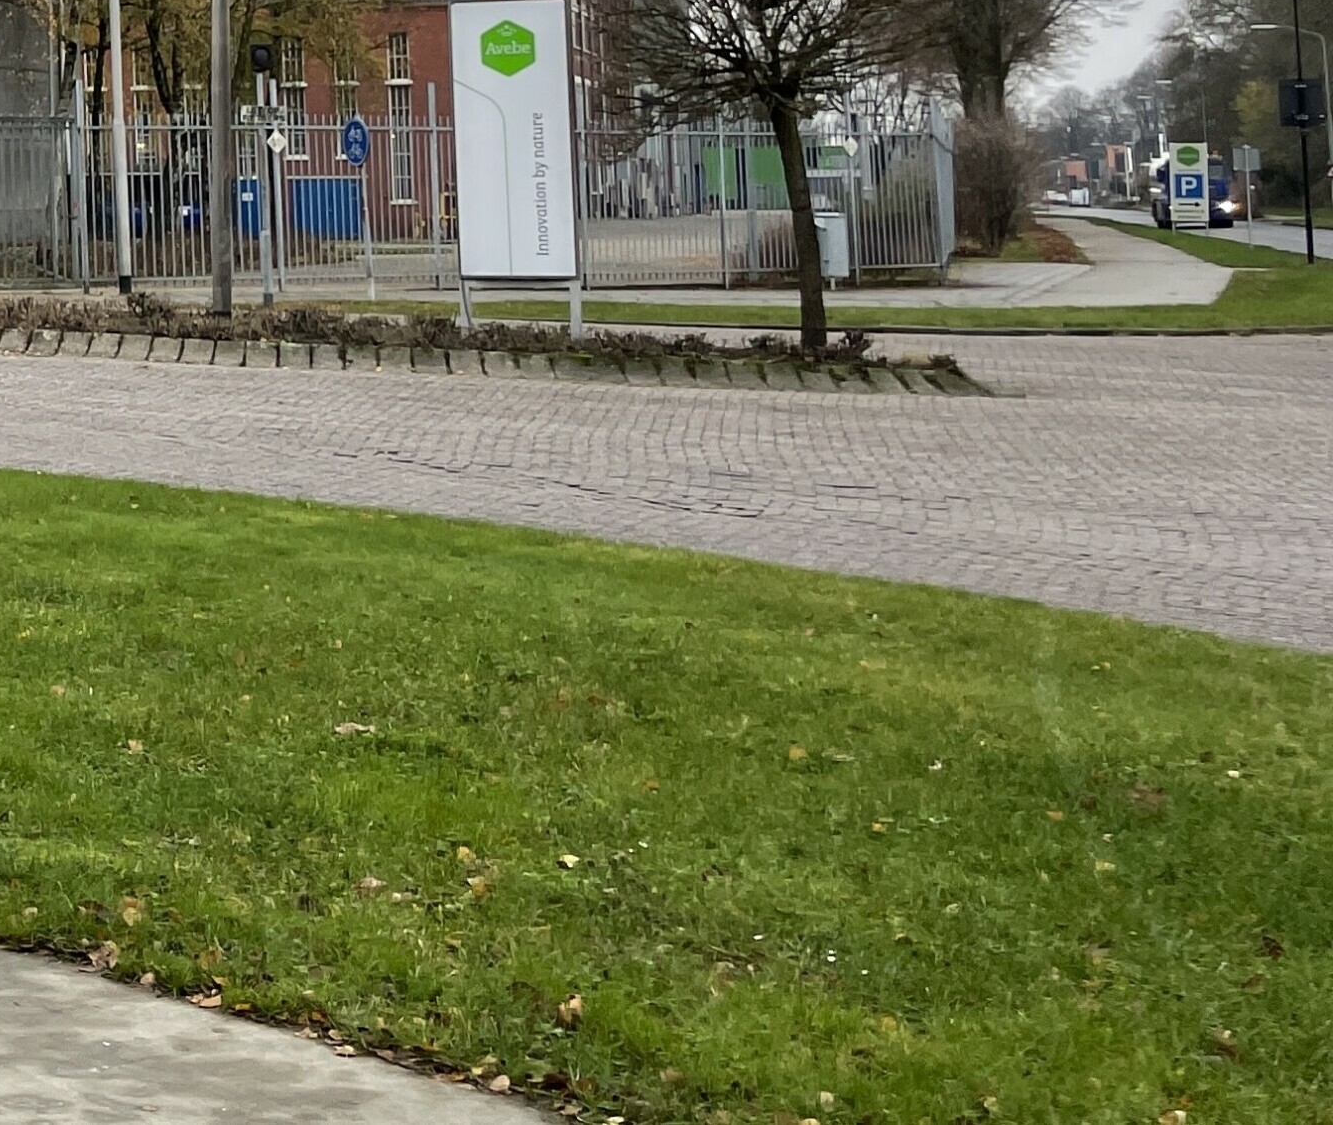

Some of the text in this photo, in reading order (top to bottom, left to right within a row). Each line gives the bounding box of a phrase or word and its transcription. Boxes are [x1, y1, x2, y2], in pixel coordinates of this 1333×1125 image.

[485, 40, 532, 55] Avebe
[532, 112, 549, 256] Innovation by nature
[1180, 176, 1198, 197] P
